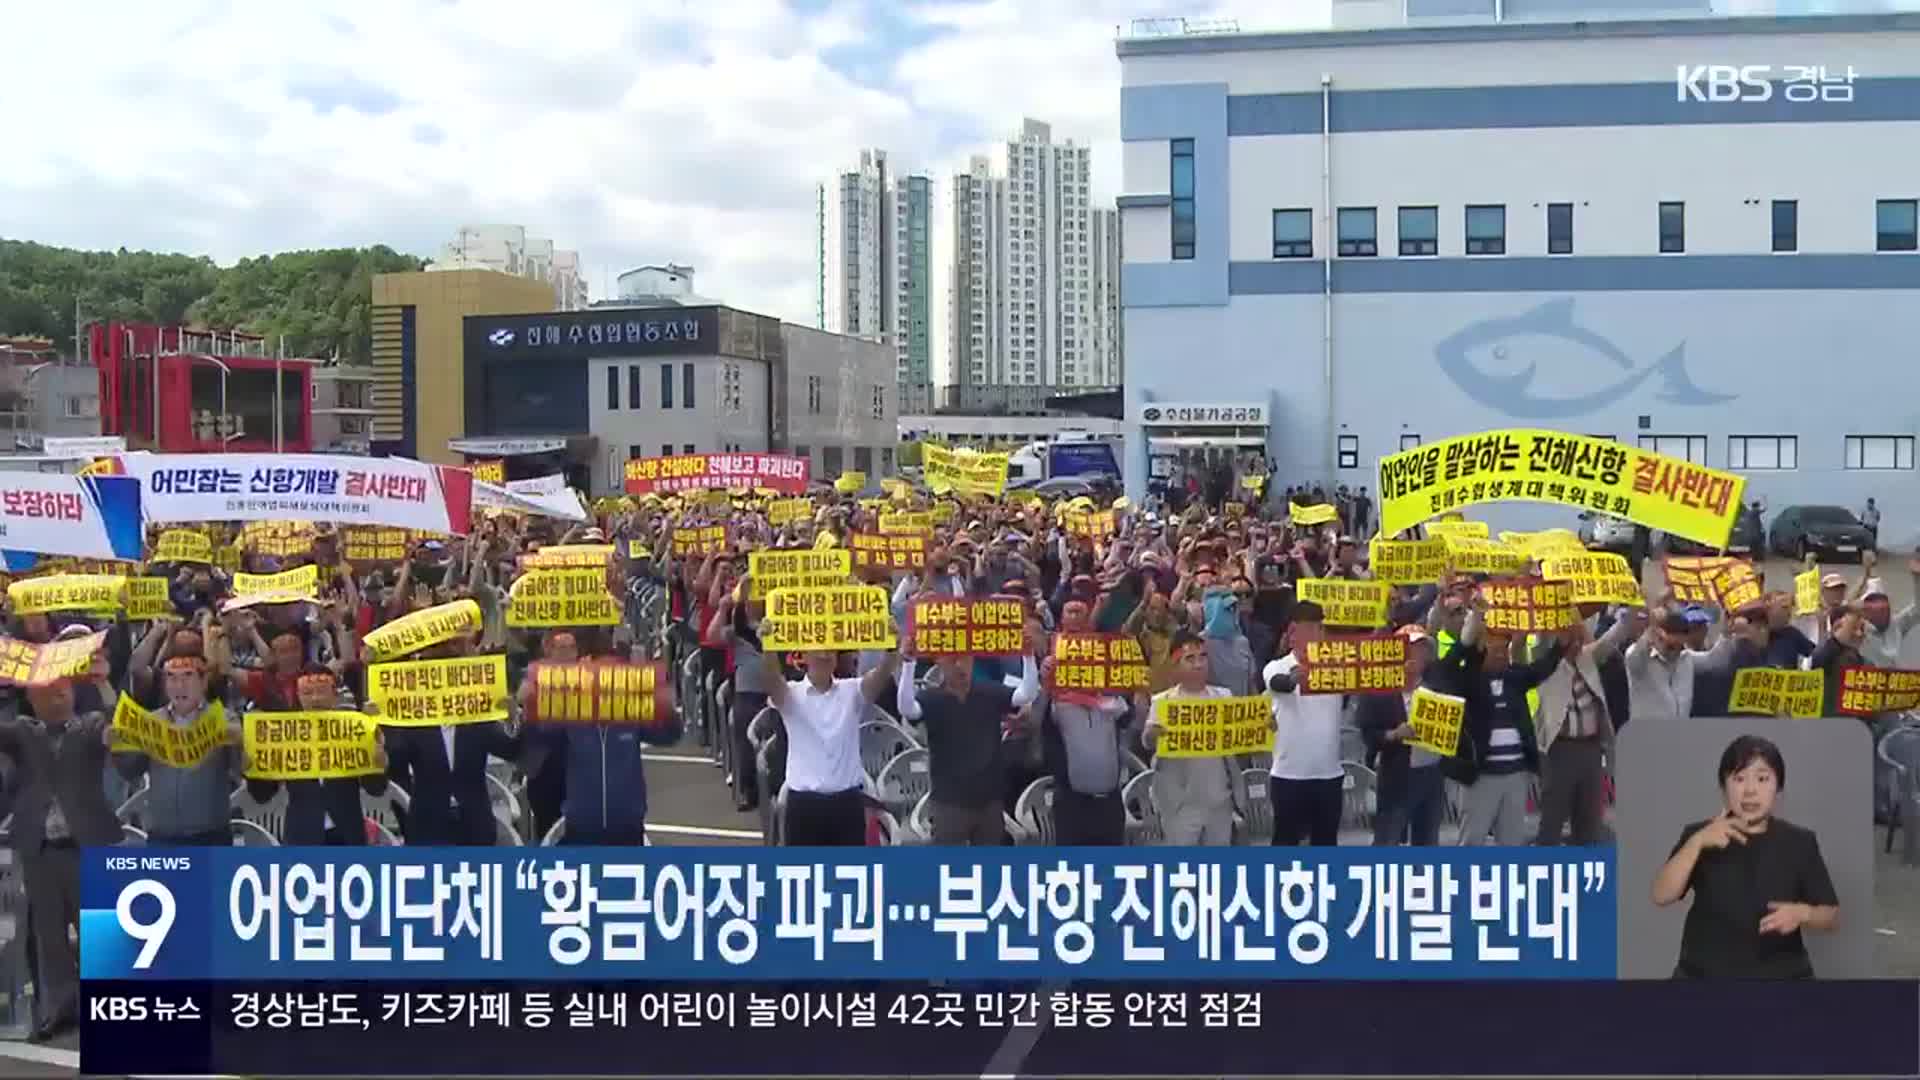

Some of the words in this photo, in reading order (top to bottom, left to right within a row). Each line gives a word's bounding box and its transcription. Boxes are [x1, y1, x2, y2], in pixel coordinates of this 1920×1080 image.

[250, 467, 339, 495] 신항개발
[345, 470, 428, 504] 결사반대
[1528, 435, 1627, 485] 진해신항
[1631, 455, 1734, 518] 결사반대
[3, 489, 83, 522] 보장하라
